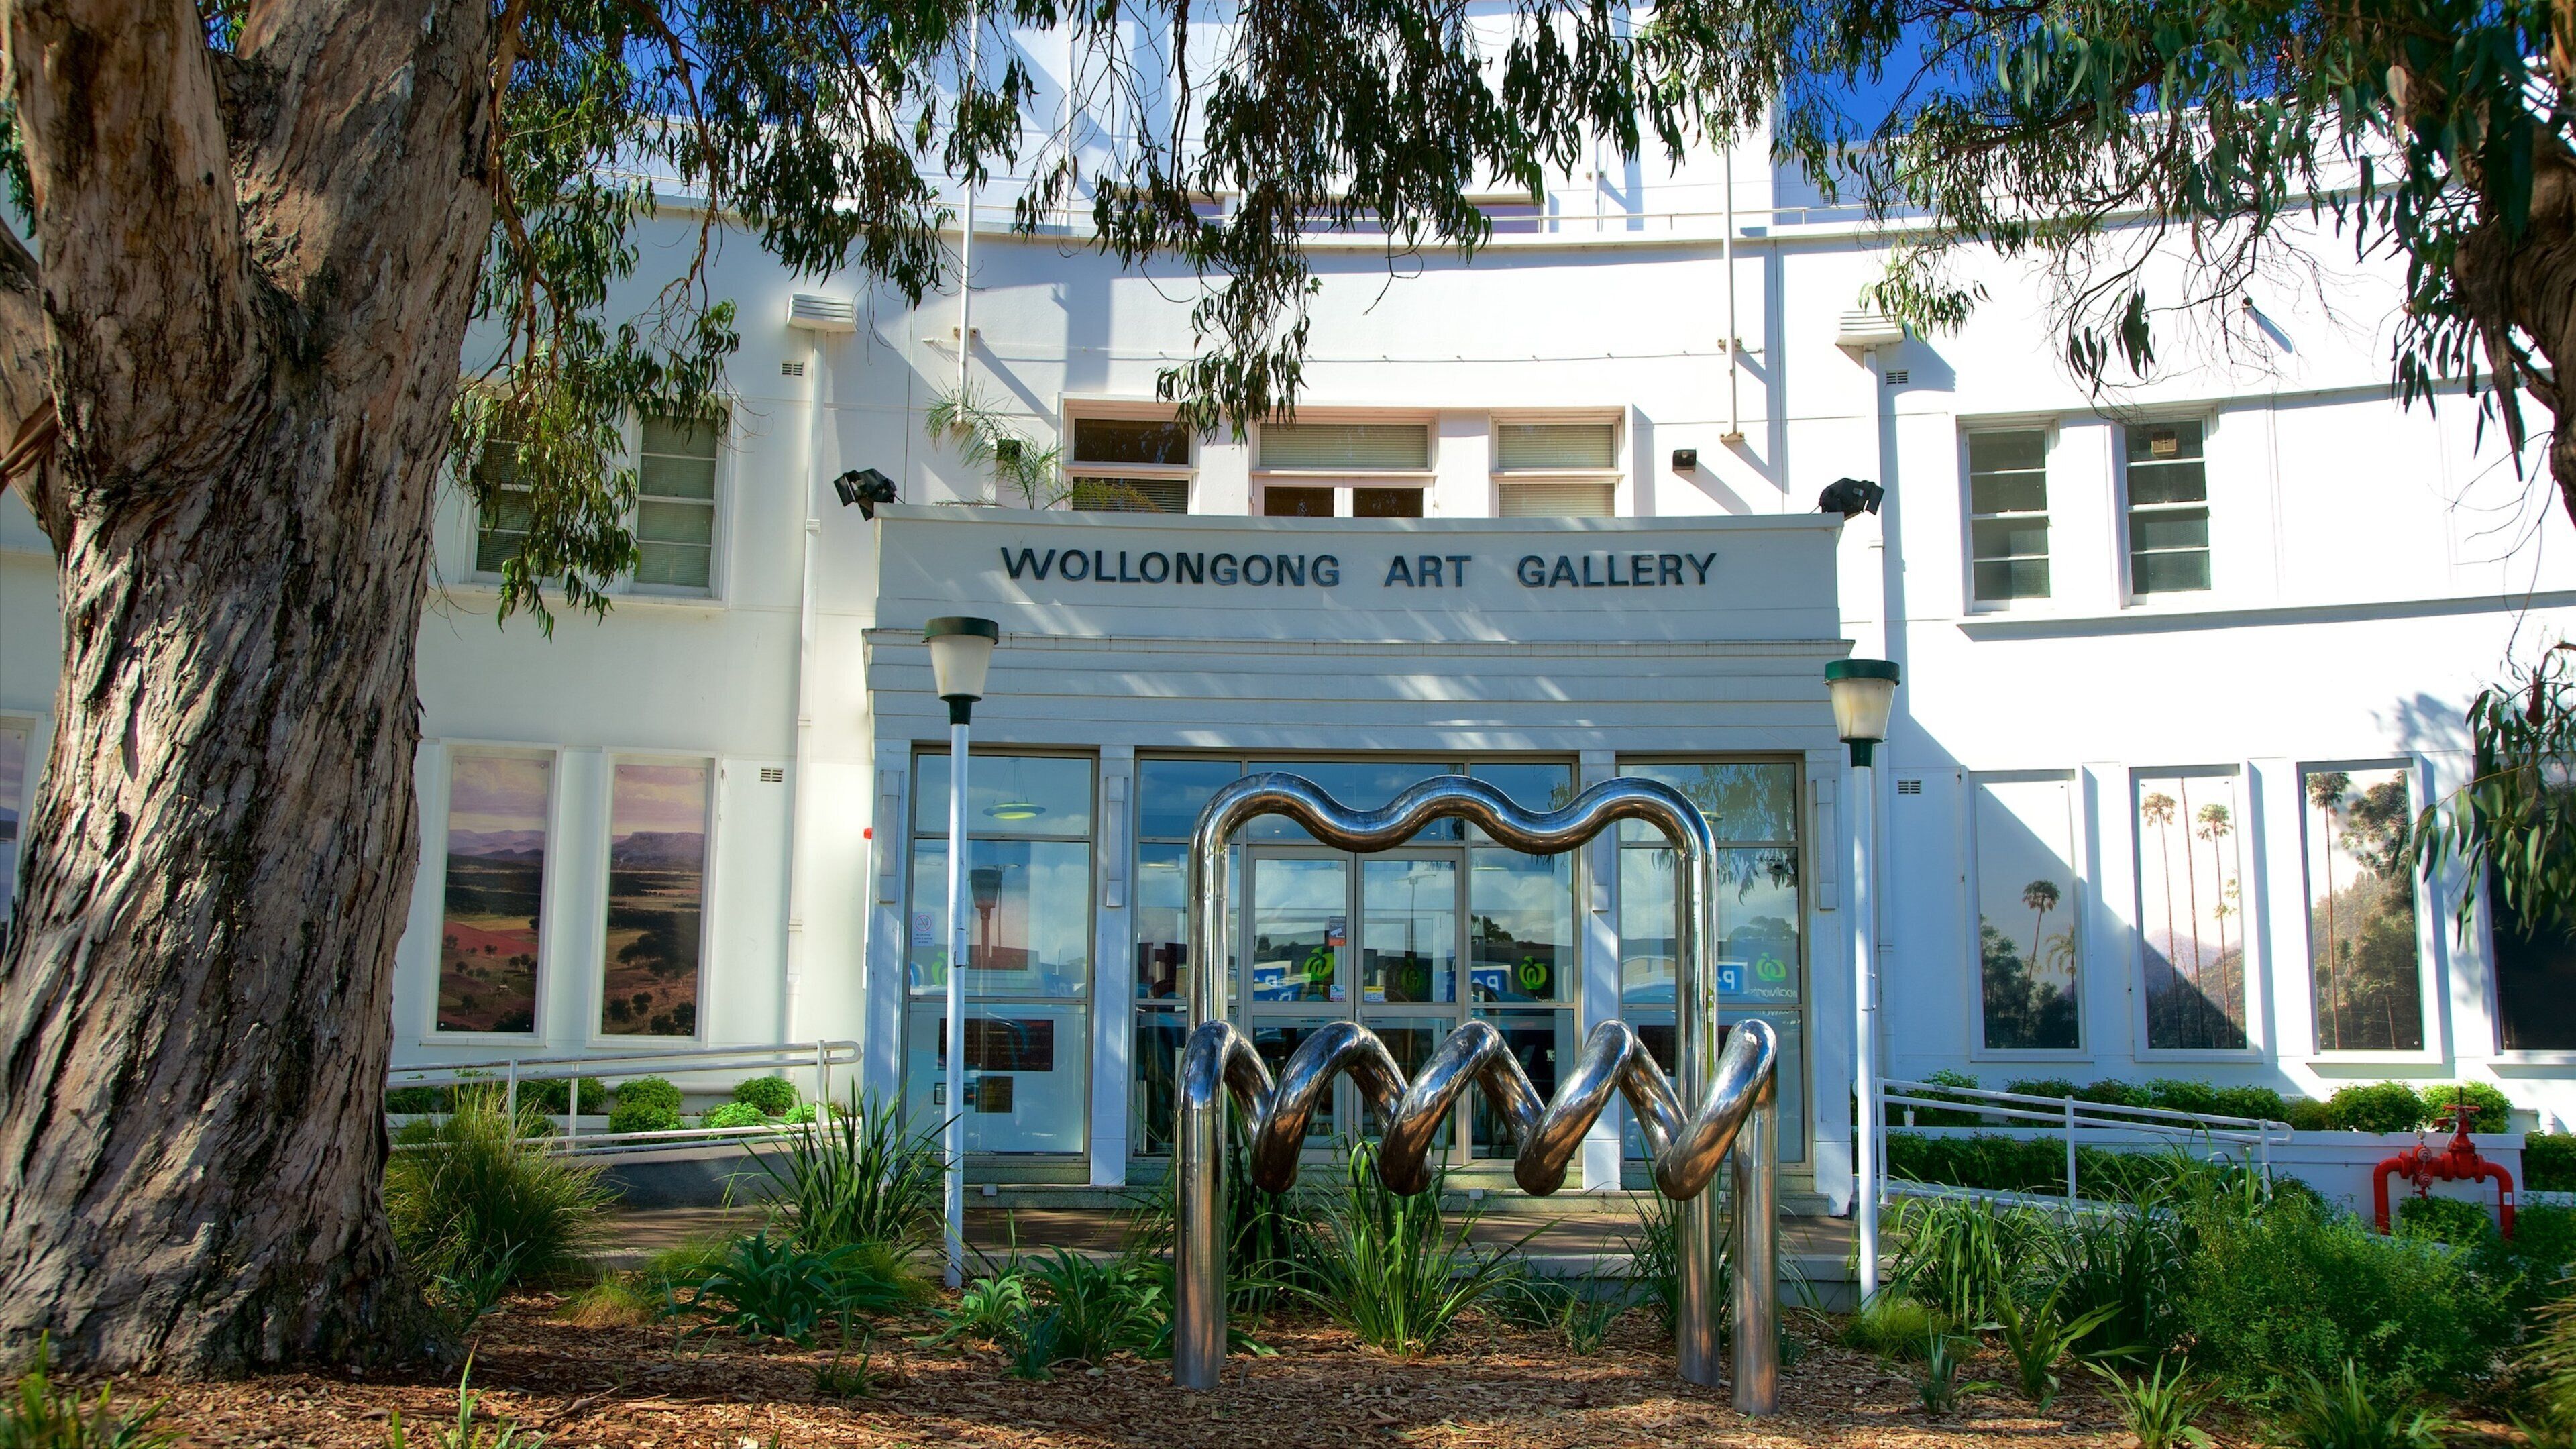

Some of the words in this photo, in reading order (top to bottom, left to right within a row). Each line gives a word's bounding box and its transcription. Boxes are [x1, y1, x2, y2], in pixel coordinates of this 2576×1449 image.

[1000, 547, 1340, 587] WOLLONGONG
[1383, 555, 1472, 588] ART
[1517, 552, 1717, 588] GALLERY
